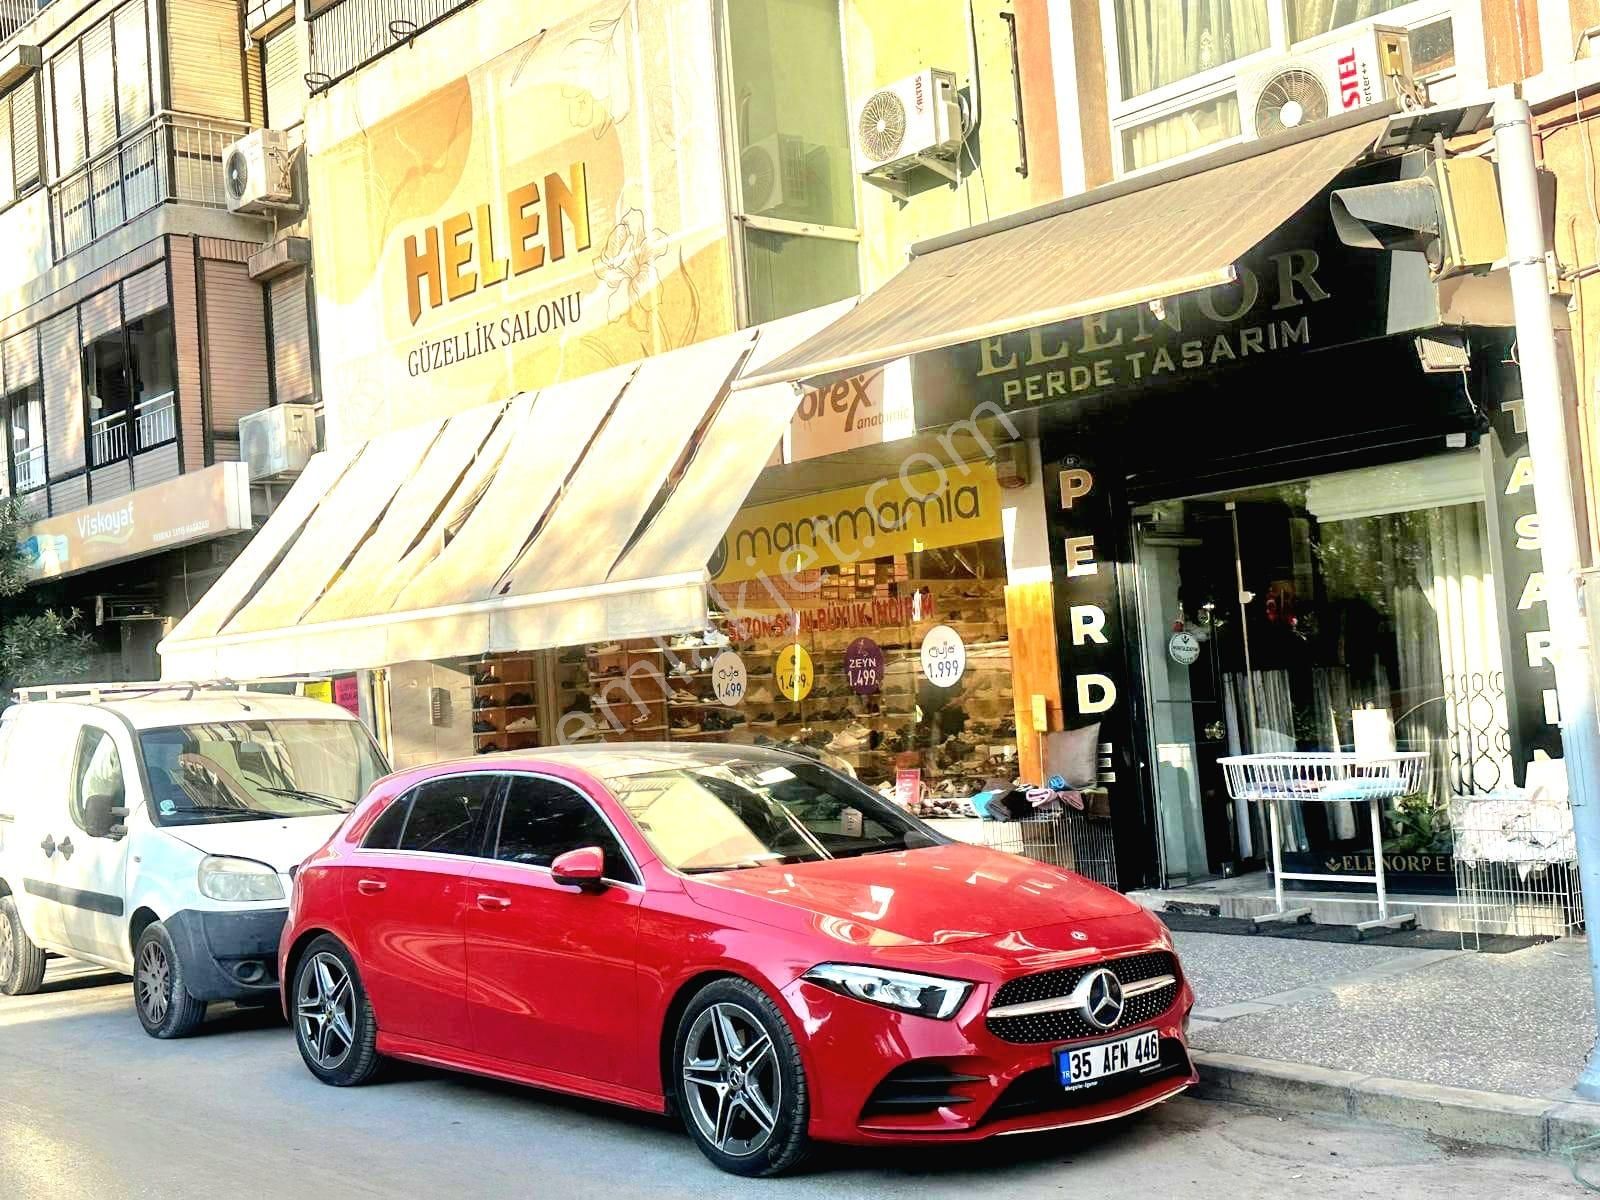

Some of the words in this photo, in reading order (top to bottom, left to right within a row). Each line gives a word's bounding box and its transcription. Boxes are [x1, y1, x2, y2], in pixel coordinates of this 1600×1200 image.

[404, 160, 591, 327] HELEN
[407, 322, 497, 377] GÜZELLİK
[500, 291, 582, 347] SALONU
[975, 249, 1332, 377] ELENOR
[1002, 360, 1116, 406] PERDE
[1125, 316, 1310, 379] TASARIM
[736, 481, 980, 561] mammamia
[717, 682, 742, 698] 1.499
[848, 657, 877, 669] ZEYN
[928, 659, 959, 679] 1.999
[1071, 1051, 1092, 1080] 35
[1103, 1041, 1129, 1074] AFN
[1135, 1033, 1158, 1063] 446
